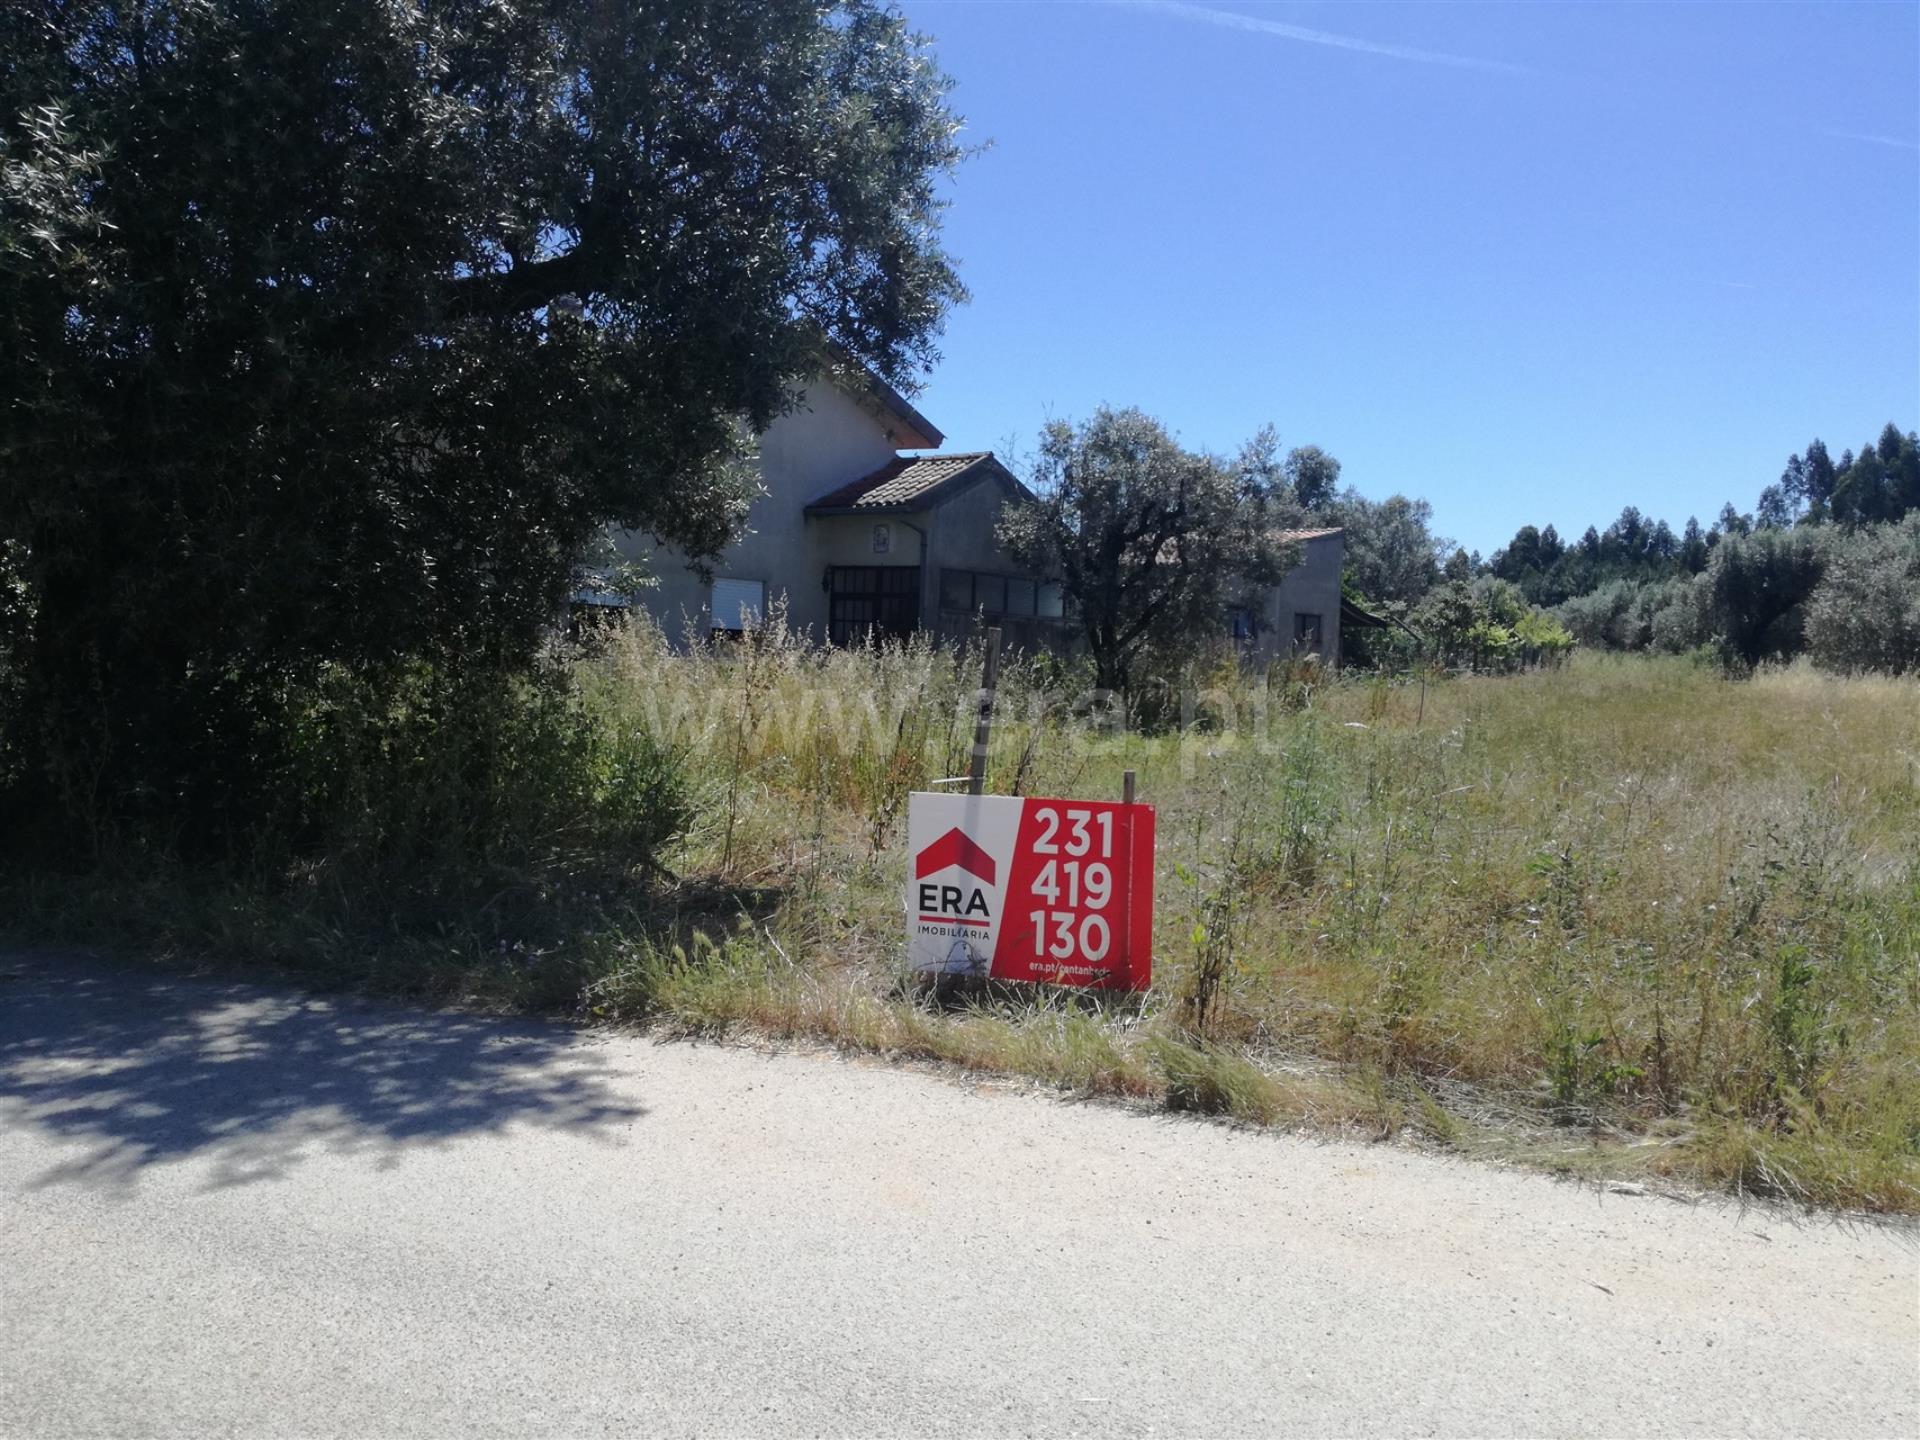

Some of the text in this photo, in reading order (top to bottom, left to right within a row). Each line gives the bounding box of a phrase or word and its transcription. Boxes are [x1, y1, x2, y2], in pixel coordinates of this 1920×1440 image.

[1032, 807, 1114, 859] 231
[918, 883, 991, 918] ERA
[1030, 859, 1113, 910] 419
[1029, 910, 1111, 961] 130
